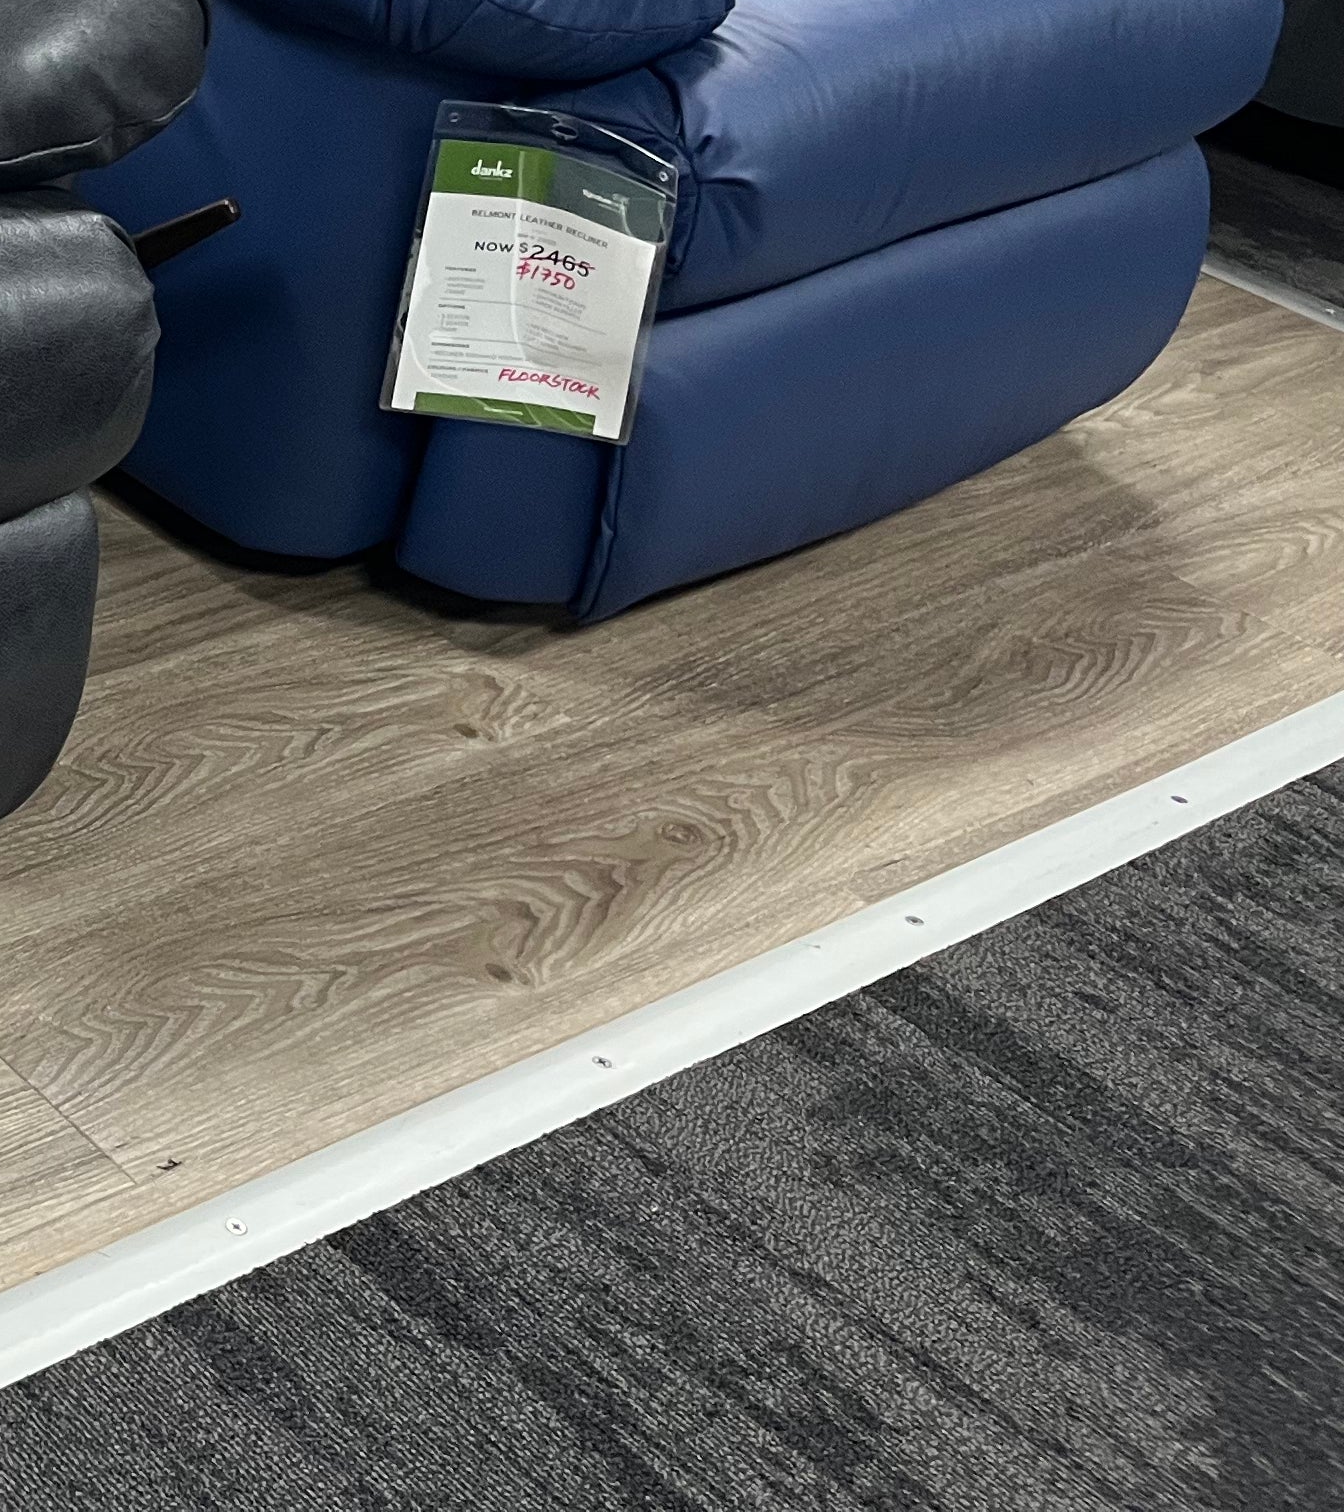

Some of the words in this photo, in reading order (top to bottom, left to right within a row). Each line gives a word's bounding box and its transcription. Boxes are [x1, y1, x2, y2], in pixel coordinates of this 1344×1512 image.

[471, 208, 517, 220] BELMONT
[519, 213, 563, 232] LEATHER
[474, 240, 514, 253] NOW
[516, 261, 576, 290] $1750
[497, 368, 601, 401] FLOORSTOCK
